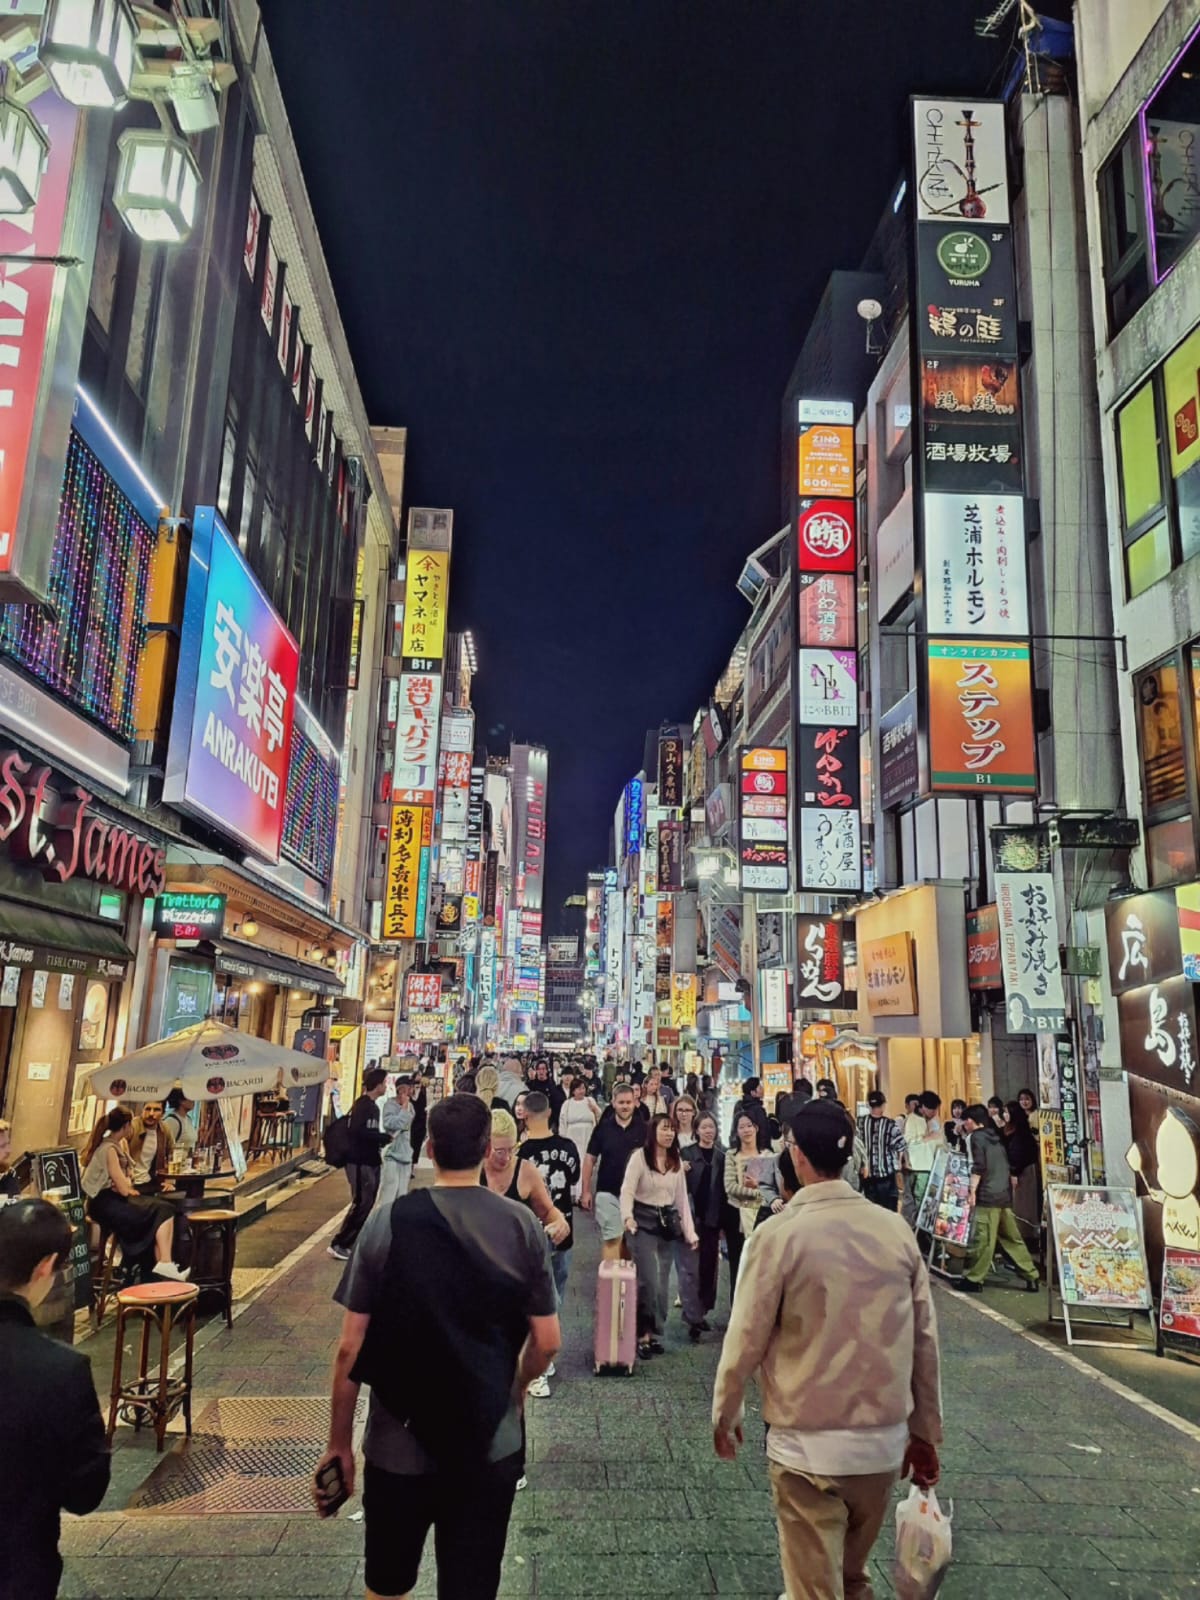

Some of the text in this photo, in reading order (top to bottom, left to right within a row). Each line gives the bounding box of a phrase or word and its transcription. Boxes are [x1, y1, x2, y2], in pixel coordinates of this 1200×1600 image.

[925, 441, 1012, 463] 酒場牧場
[963, 503, 985, 625] 芝浦ホルモン
[408, 573, 430, 653] ヤマネ肉店
[940, 646, 1017, 657] オンラインカフェ
[411, 659, 433, 671] B1F
[209, 600, 288, 752] 安楽亭
[955, 661, 1006, 770] ステップ
[202, 711, 280, 811] ANRAKUTEI
[975, 773, 992, 784] B1
[402, 790, 425, 803] 4F
[56, 786, 167, 898] James
[835, 810, 857, 872] 居酒屋
[161, 893, 221, 909] Trattoria
[174, 924, 198, 936] Bar
[1001, 883, 1019, 987] HIROSHIMA TEPPANYAKI
[1036, 1014, 1065, 1030] B1F
[127, 1085, 159, 1094] BACARDI
[226, 1076, 264, 1089] BACARDI
